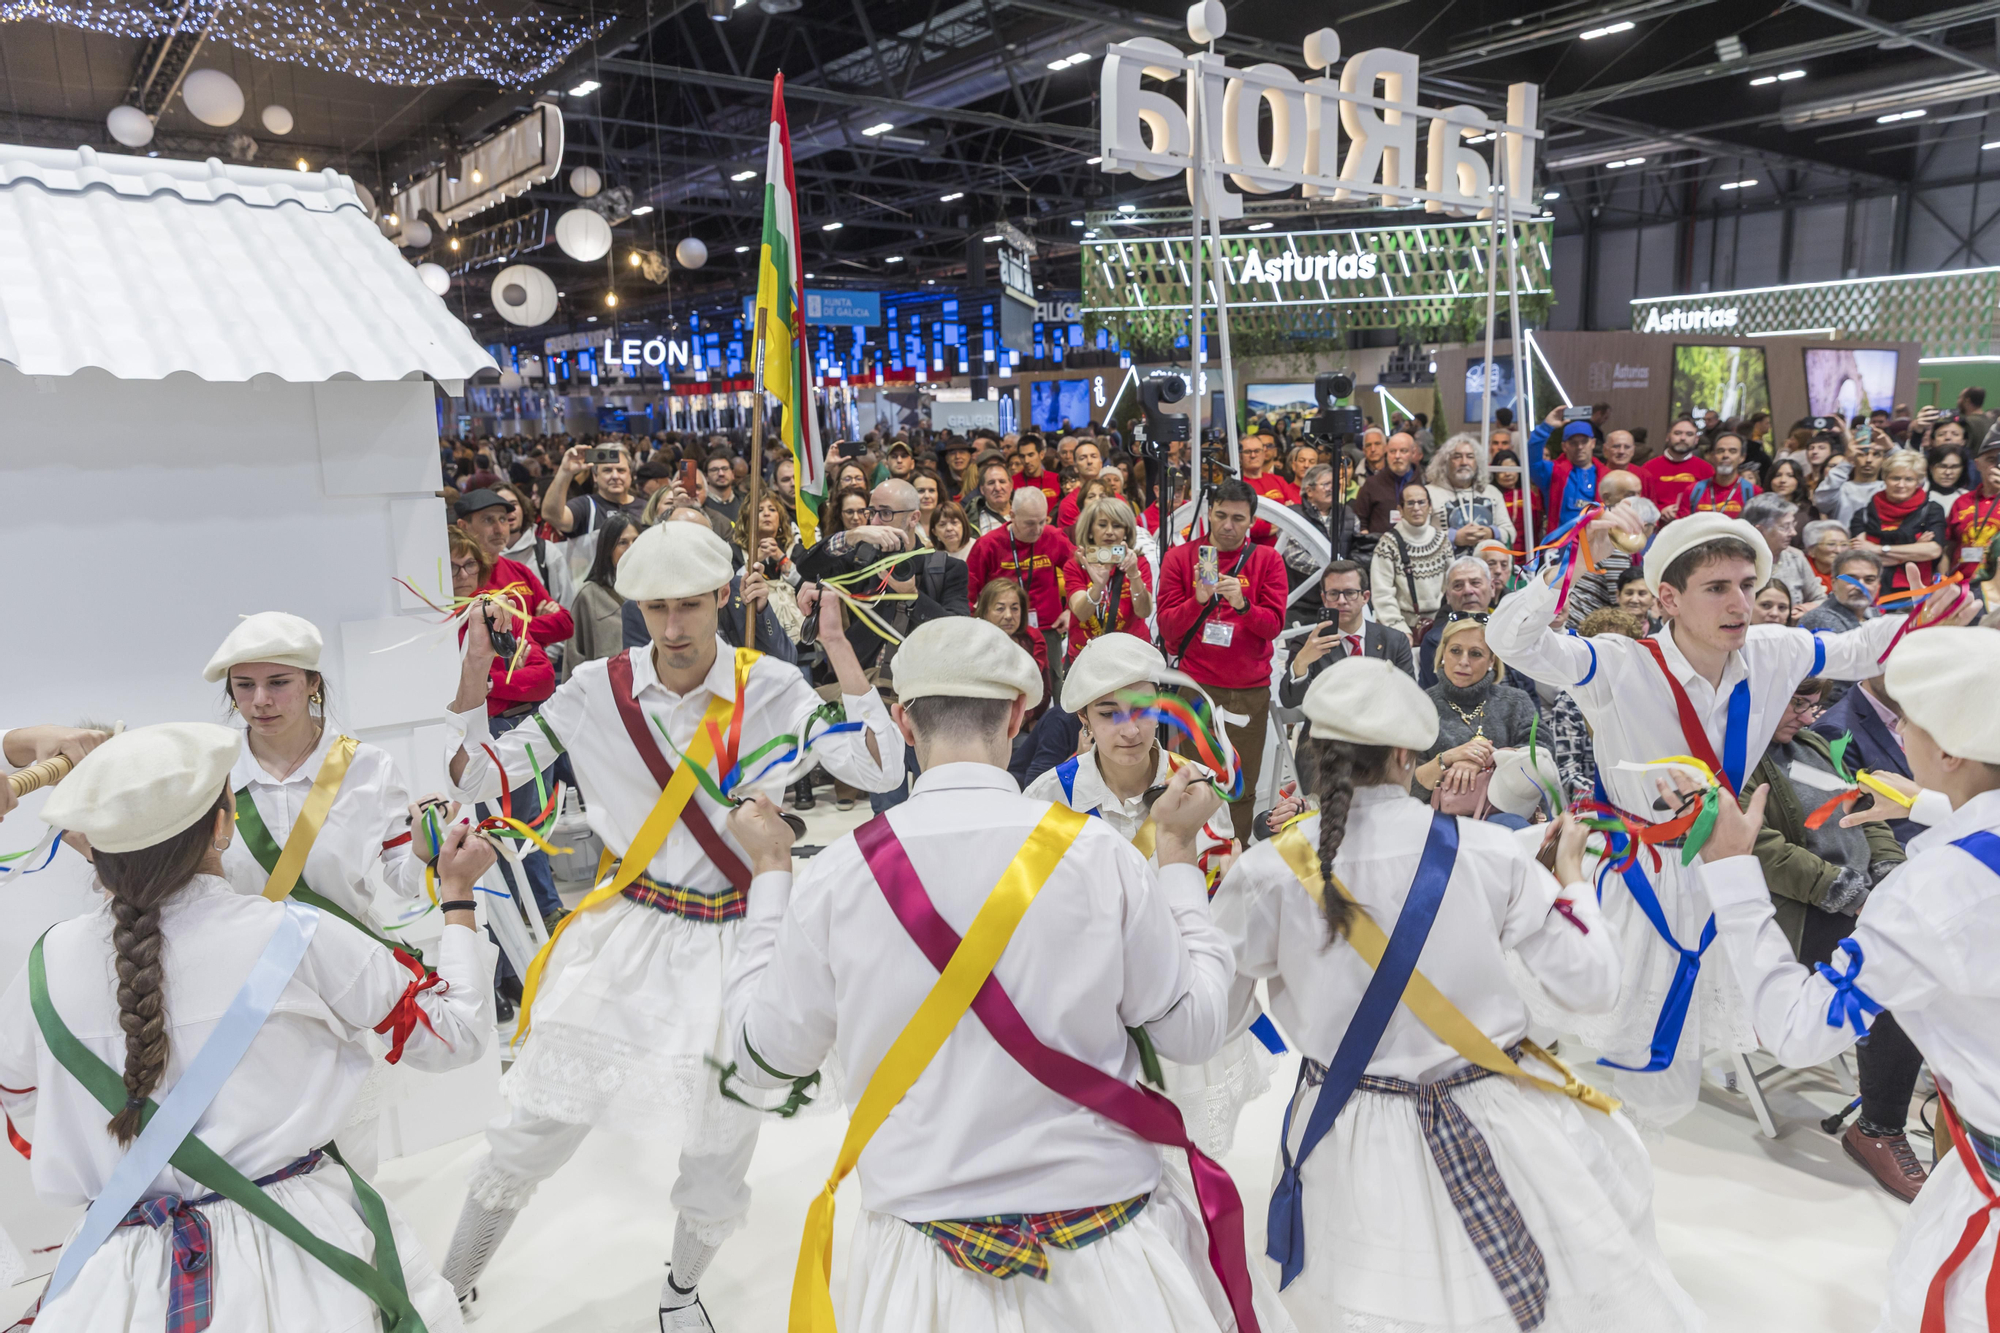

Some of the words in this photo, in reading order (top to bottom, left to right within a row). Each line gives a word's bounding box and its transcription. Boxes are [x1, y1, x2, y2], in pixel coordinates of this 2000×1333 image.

[1240, 248, 1377, 284] Asturias
[823, 297, 853, 307] XUNTA
[823, 306, 834, 317] DE
[836, 308, 870, 319] GALICIA
[1643, 306, 1739, 334] Asturias
